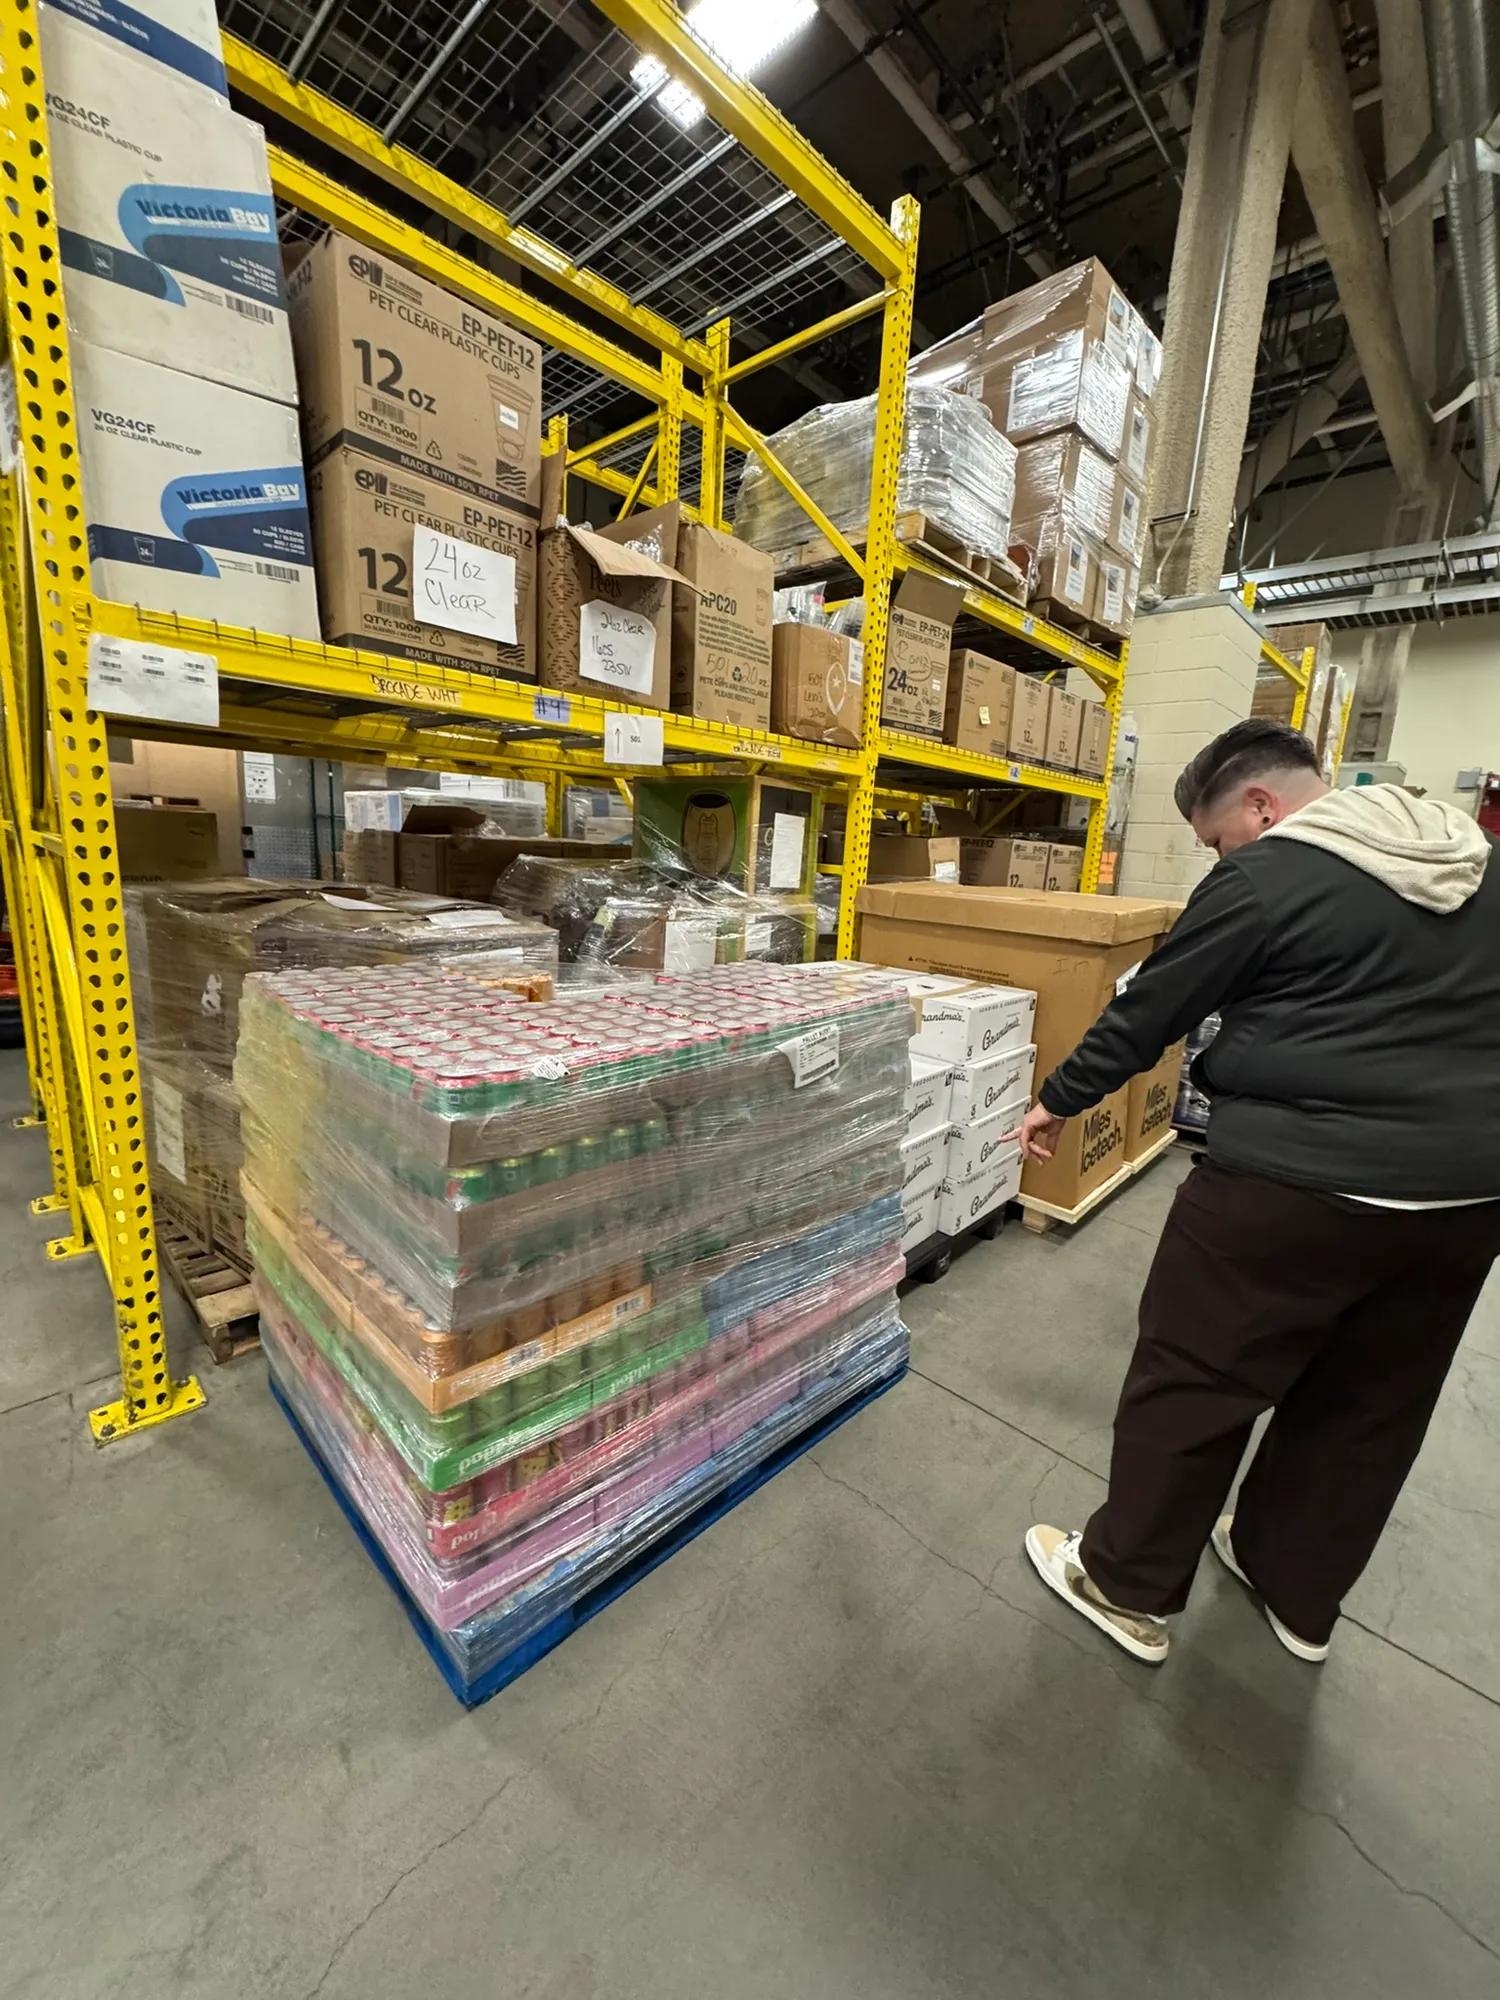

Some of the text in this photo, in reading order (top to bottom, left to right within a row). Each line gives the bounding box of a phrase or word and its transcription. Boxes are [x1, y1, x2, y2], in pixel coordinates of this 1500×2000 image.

[136, 199, 231, 222] Victoria
[369, 289, 521, 380] PET CLEAR PLASTIC CUPS
[462, 311, 536, 371] EP-PET-12
[352, 338, 405, 401] 12
[91, 408, 156, 435] VG24CF
[358, 410, 388, 430] QTY:
[389, 422, 418, 441] 1000
[120, 429, 149, 443] CLEAR
[150, 437, 184, 452] PLASTIC
[176, 483, 300, 504] Victoria Bay
[400, 454, 430, 474] MADE
[431, 465, 457, 486] WITH
[457, 475, 476, 492] 50%
[477, 484, 501, 502] RPET
[374, 498, 520, 559] PET CLEAR PLASTIC CUPS
[463, 506, 533, 548] EP-PET-12
[358, 547, 409, 598] 12
[363, 614, 422, 634] QTY: 1000
[405, 647, 501, 676] MADE WITH 50% RPET
[714, 689, 733, 700] PLEASE
[887, 667, 908, 694] 24
[1083, 1109, 1112, 1149] Miles
[1080, 1120, 1123, 1177] Icetech
